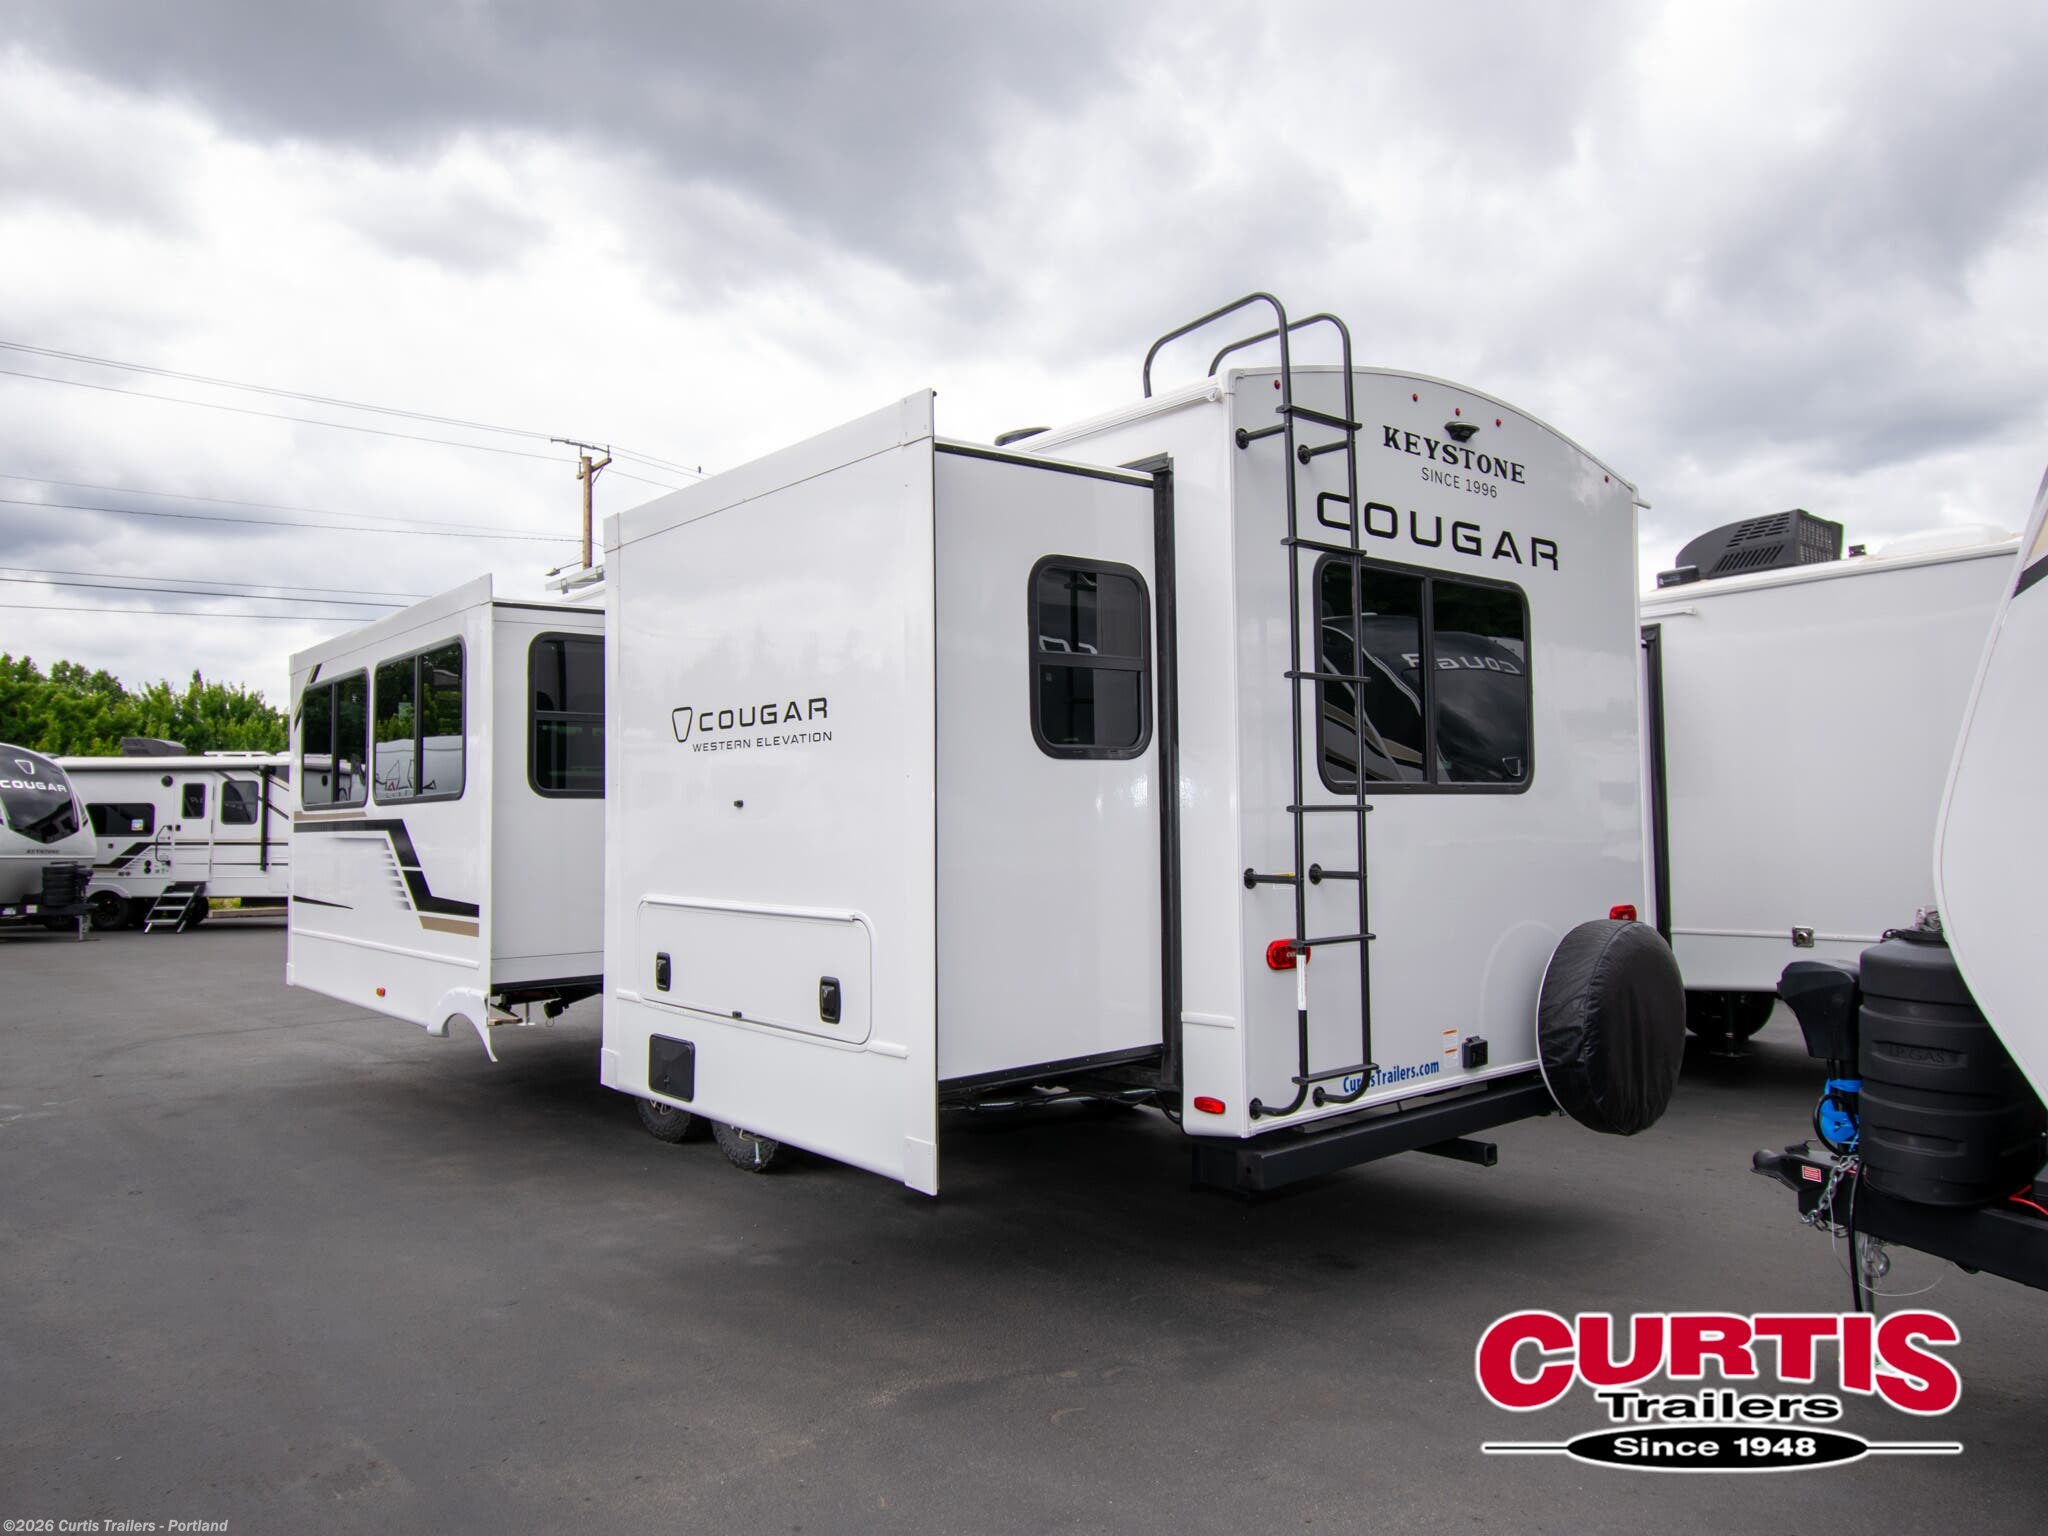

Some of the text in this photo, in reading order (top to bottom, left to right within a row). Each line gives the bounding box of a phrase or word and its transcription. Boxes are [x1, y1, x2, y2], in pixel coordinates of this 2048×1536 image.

[1382, 424, 1526, 485] KEYSTONE
[1421, 466, 1498, 499] SINCE 1996
[1316, 491, 1559, 571] COUGAR
[699, 697, 828, 732] COUGAR
[692, 731, 833, 753] WESTERN ELEVATION
[0, 779, 68, 793] COUGAR
[1343, 1060, 1440, 1093] CursTrailers.com
